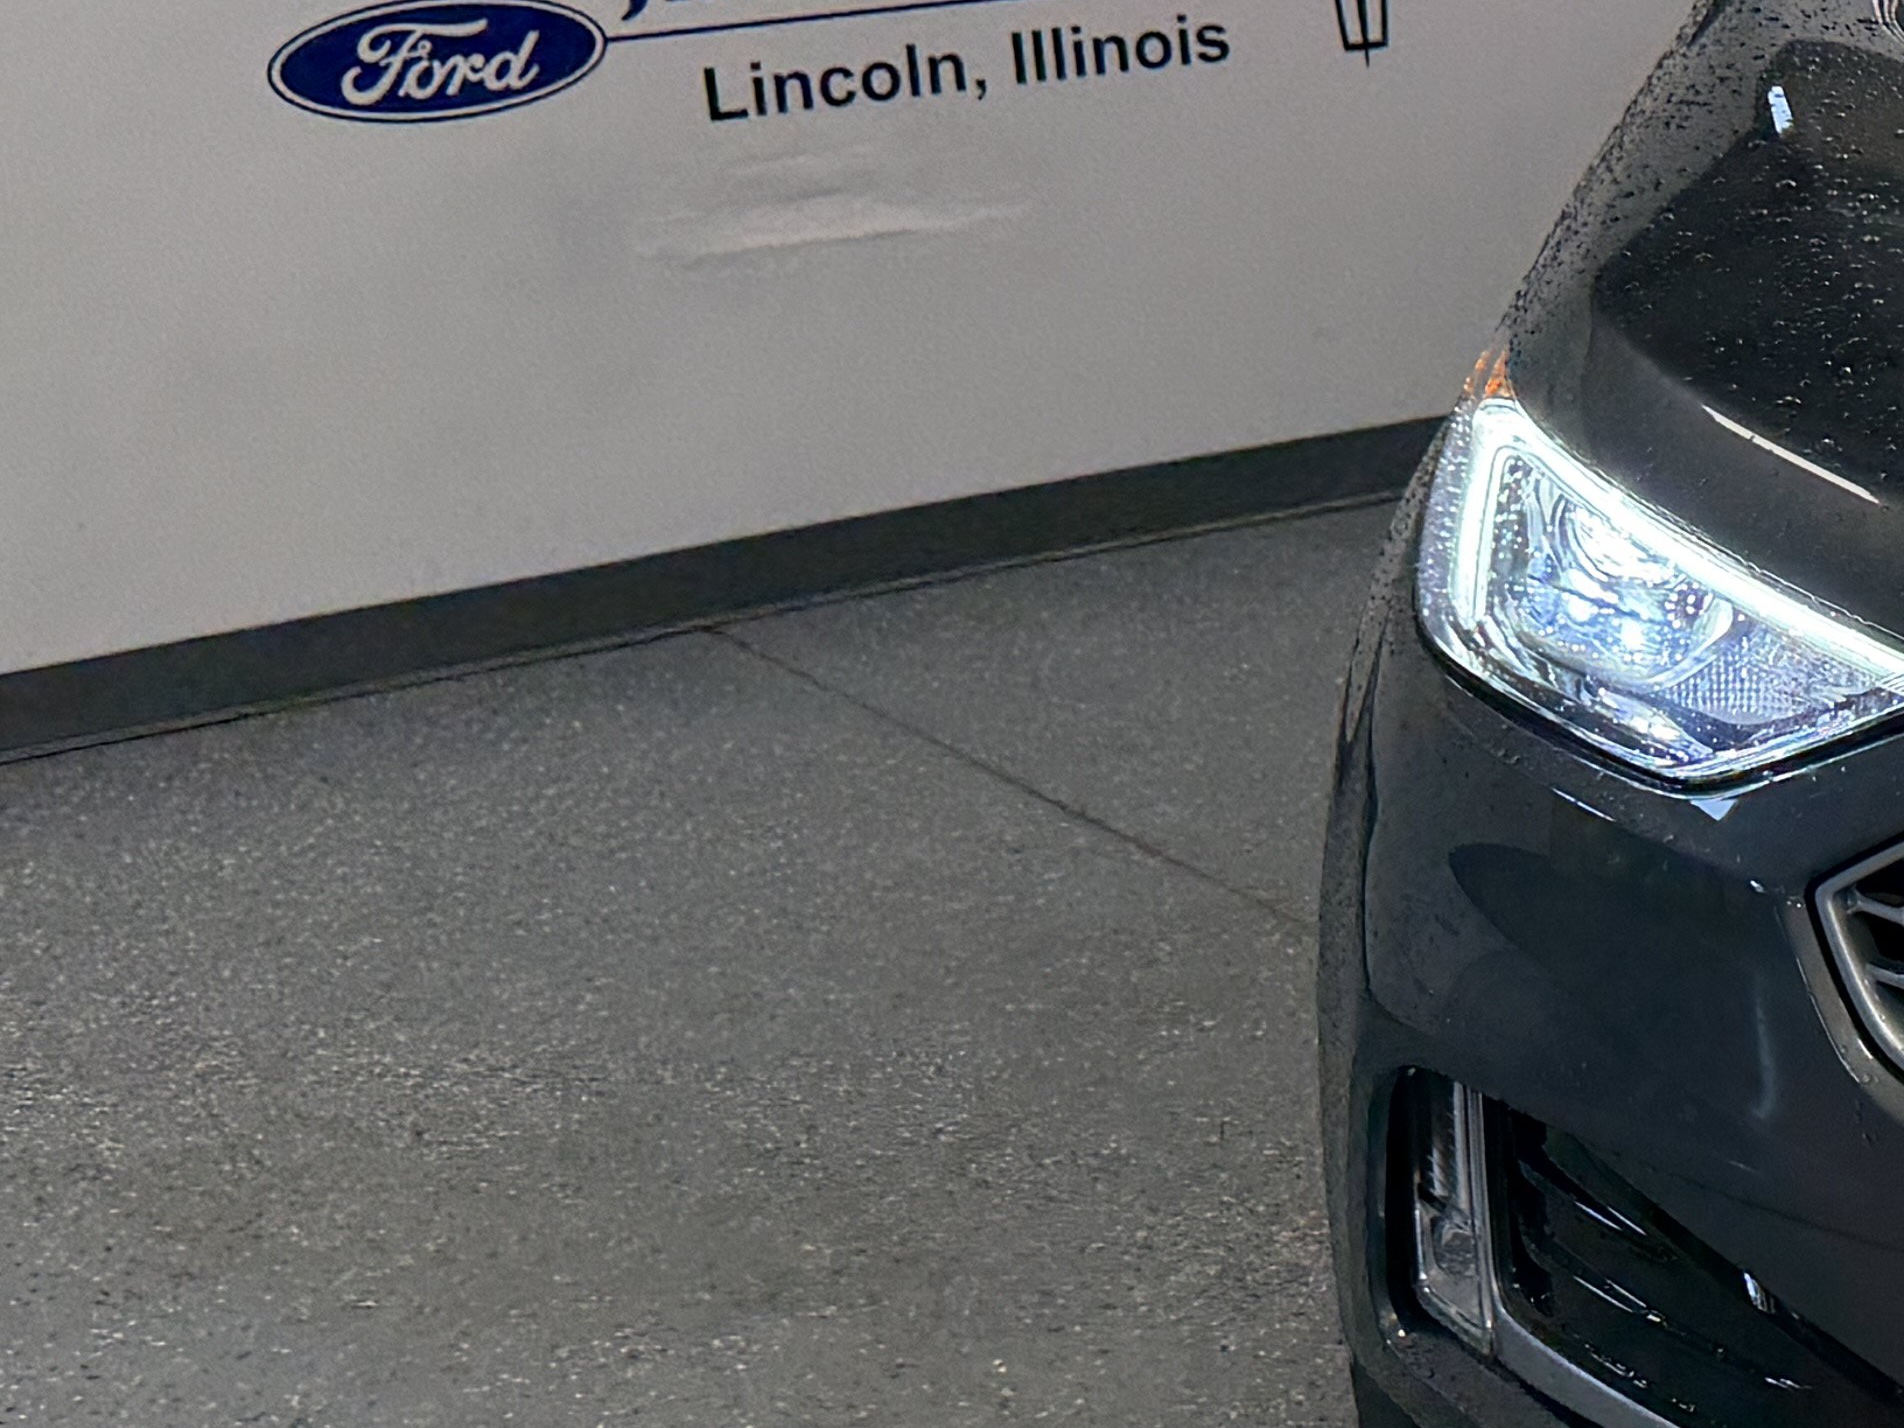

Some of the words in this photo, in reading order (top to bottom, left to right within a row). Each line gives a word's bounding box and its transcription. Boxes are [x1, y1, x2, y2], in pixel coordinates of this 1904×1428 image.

[341, 17, 539, 106] Ford
[704, 45, 989, 122] Lincoln,
[1010, 15, 1231, 86] Illinois
